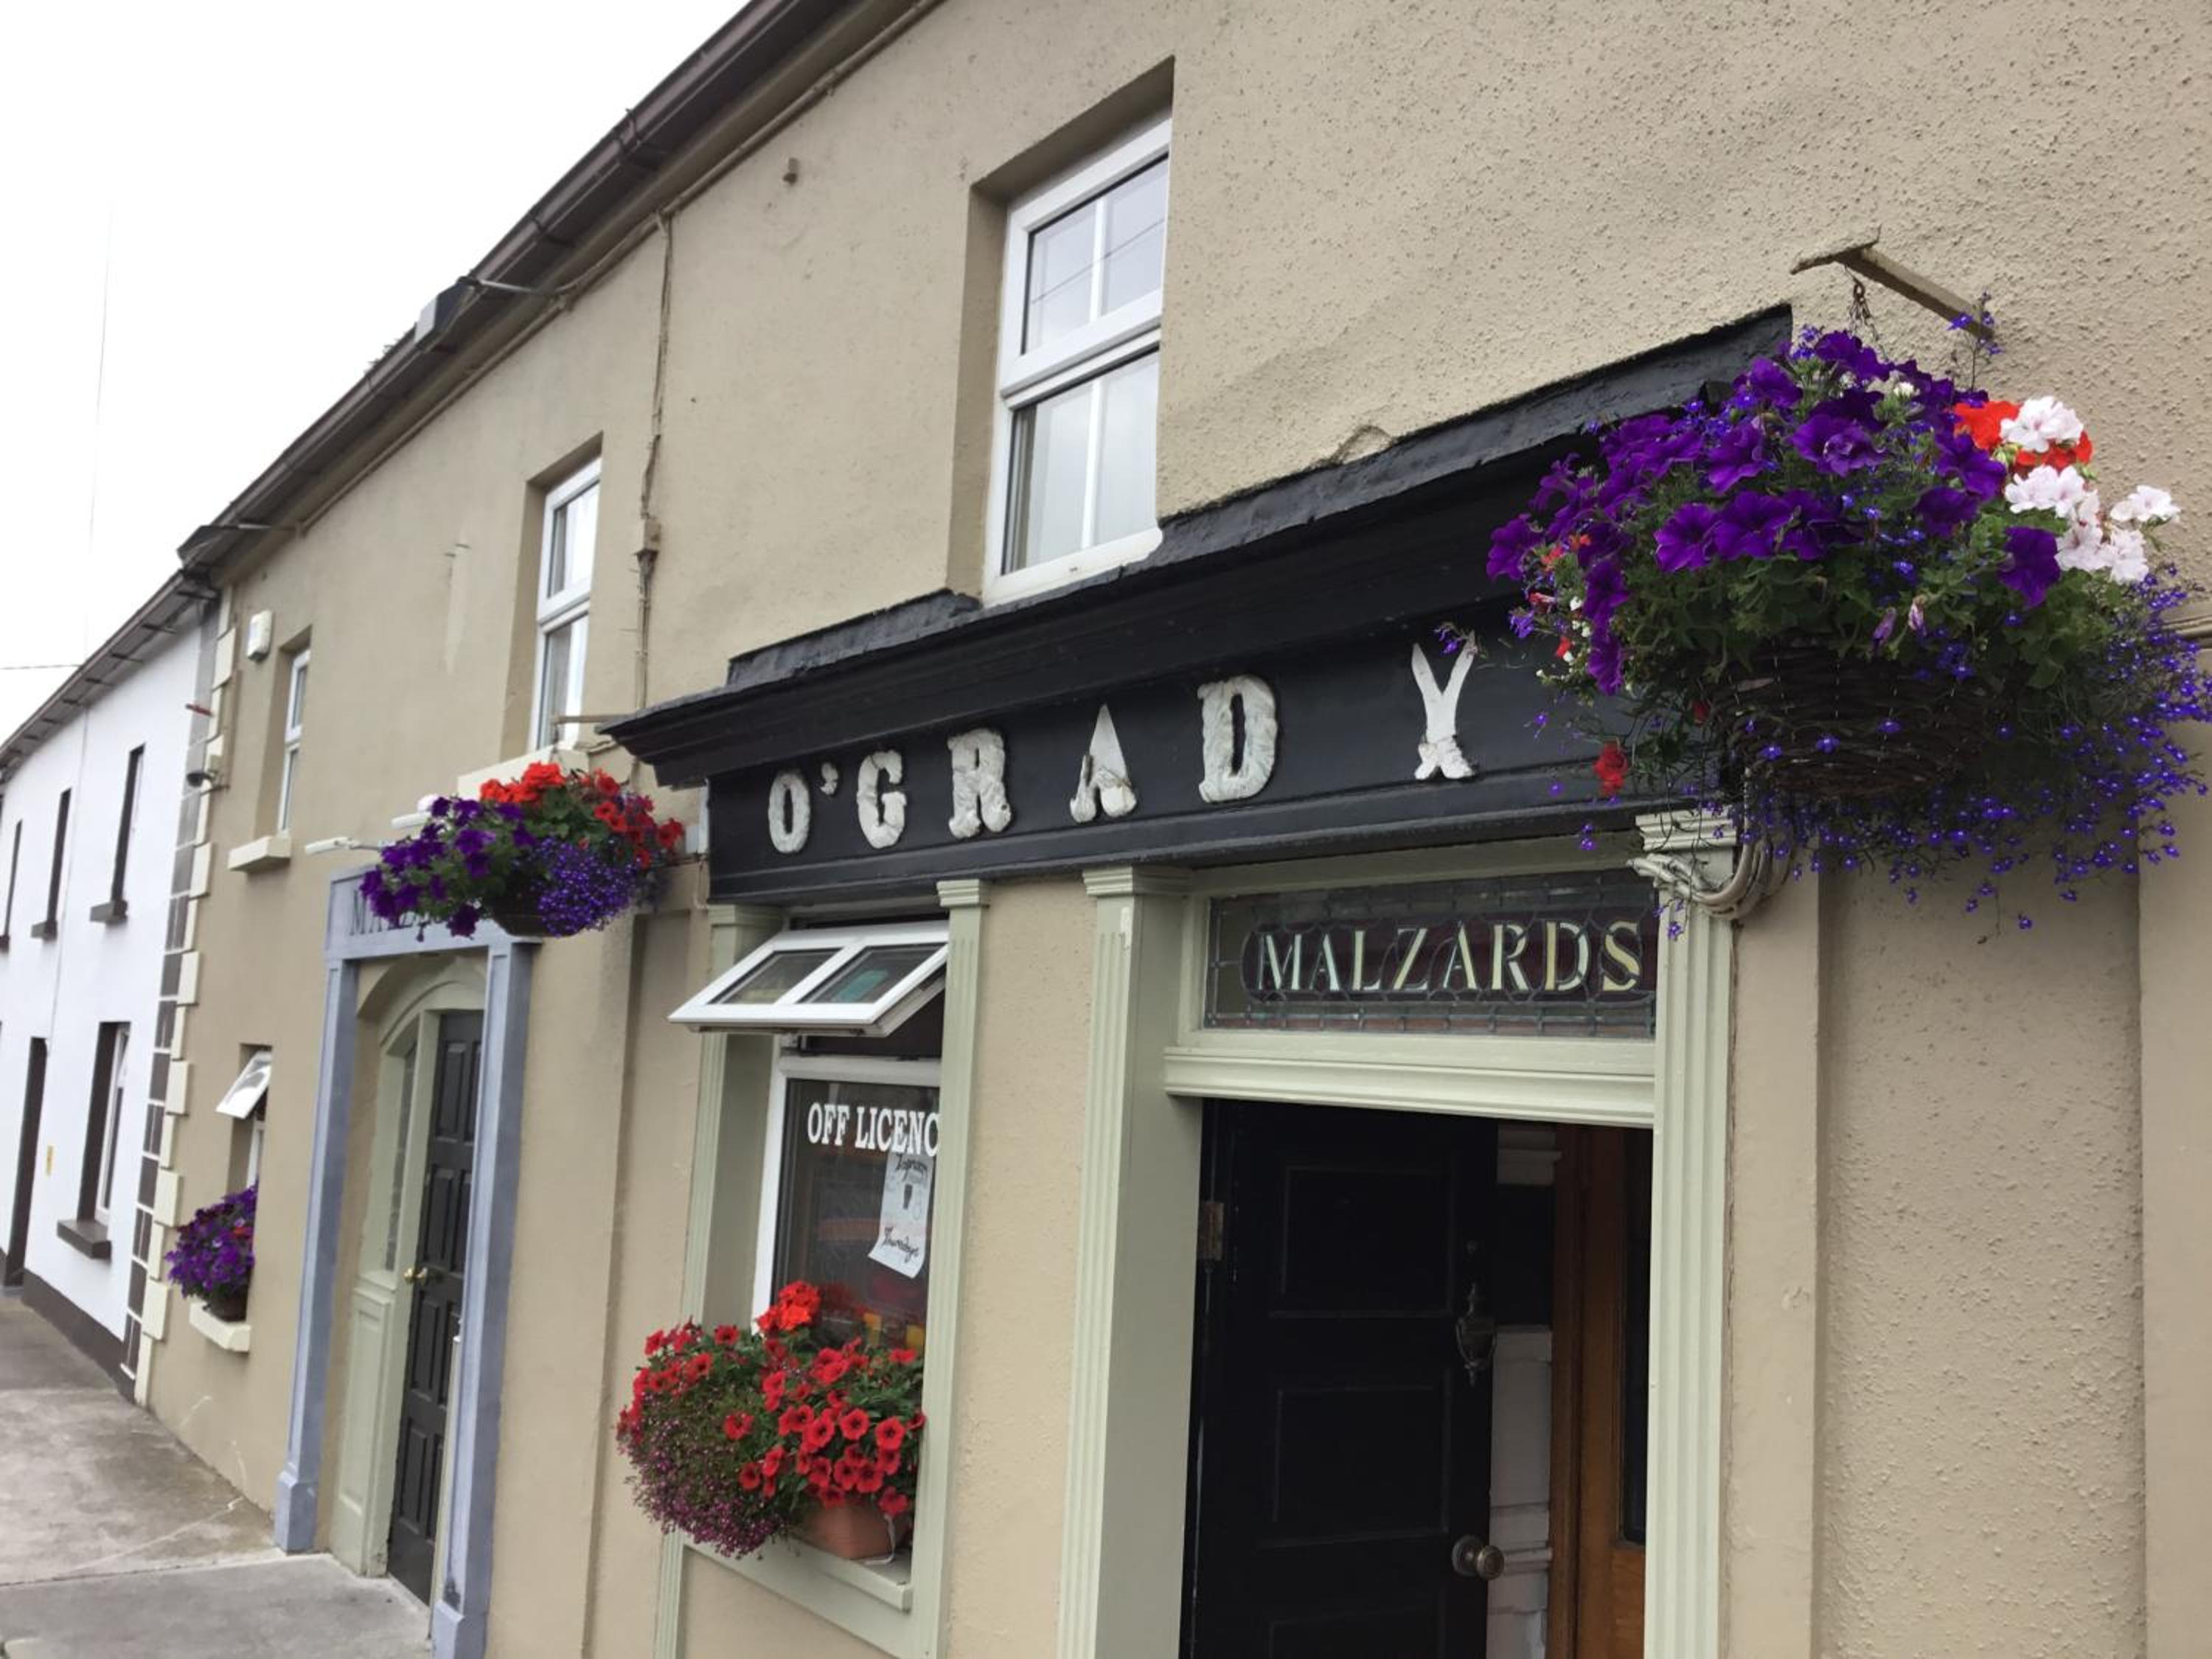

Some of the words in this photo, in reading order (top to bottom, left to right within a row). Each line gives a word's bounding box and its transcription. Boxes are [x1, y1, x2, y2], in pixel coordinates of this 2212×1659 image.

[767, 629, 1476, 855] O'GRADY
[1256, 919, 1644, 993] MALZARDS
[807, 1102, 850, 1147] OFF
